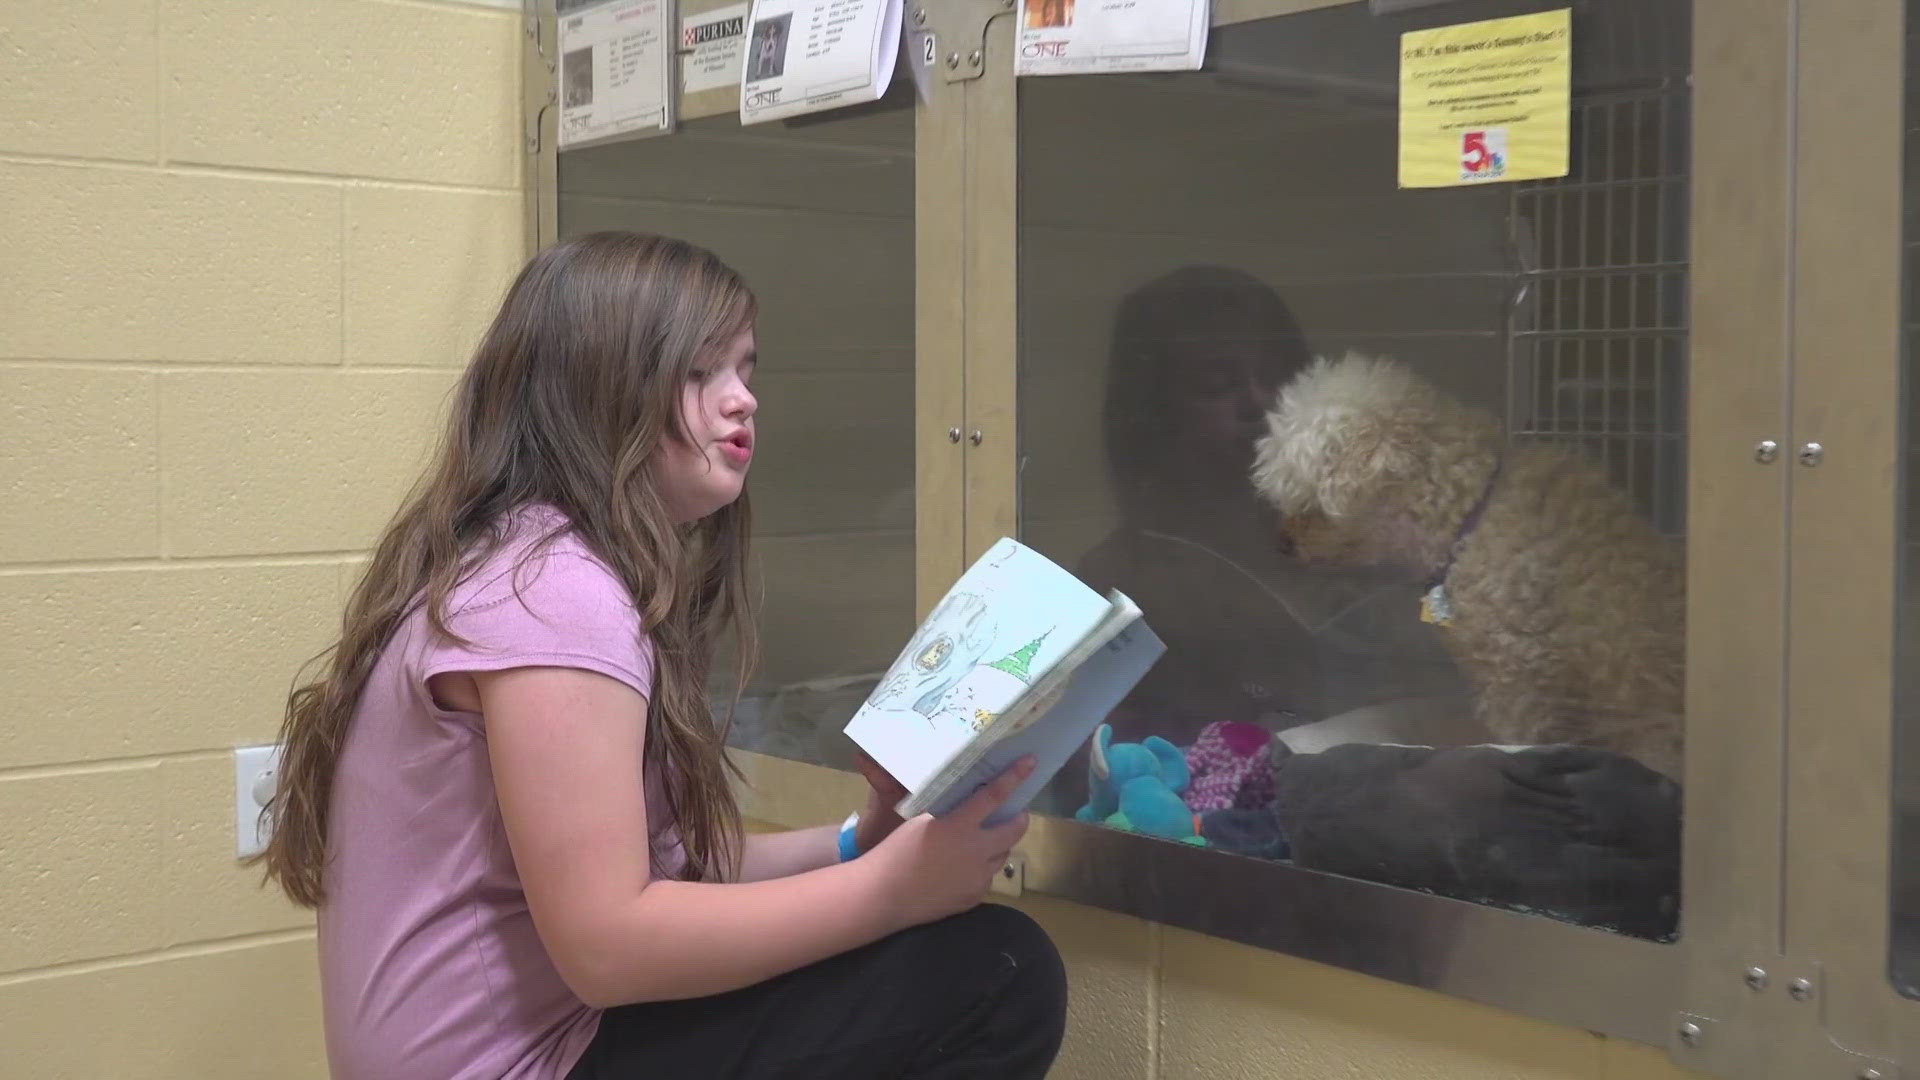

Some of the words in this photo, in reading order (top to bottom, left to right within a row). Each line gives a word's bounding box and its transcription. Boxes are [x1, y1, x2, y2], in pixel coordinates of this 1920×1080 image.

[696, 19, 741, 43] PURINA
[926, 37, 933, 61] 2
[1022, 41, 1070, 58] ONE
[746, 87, 783, 107] ONE
[1461, 131, 1486, 171] 5
